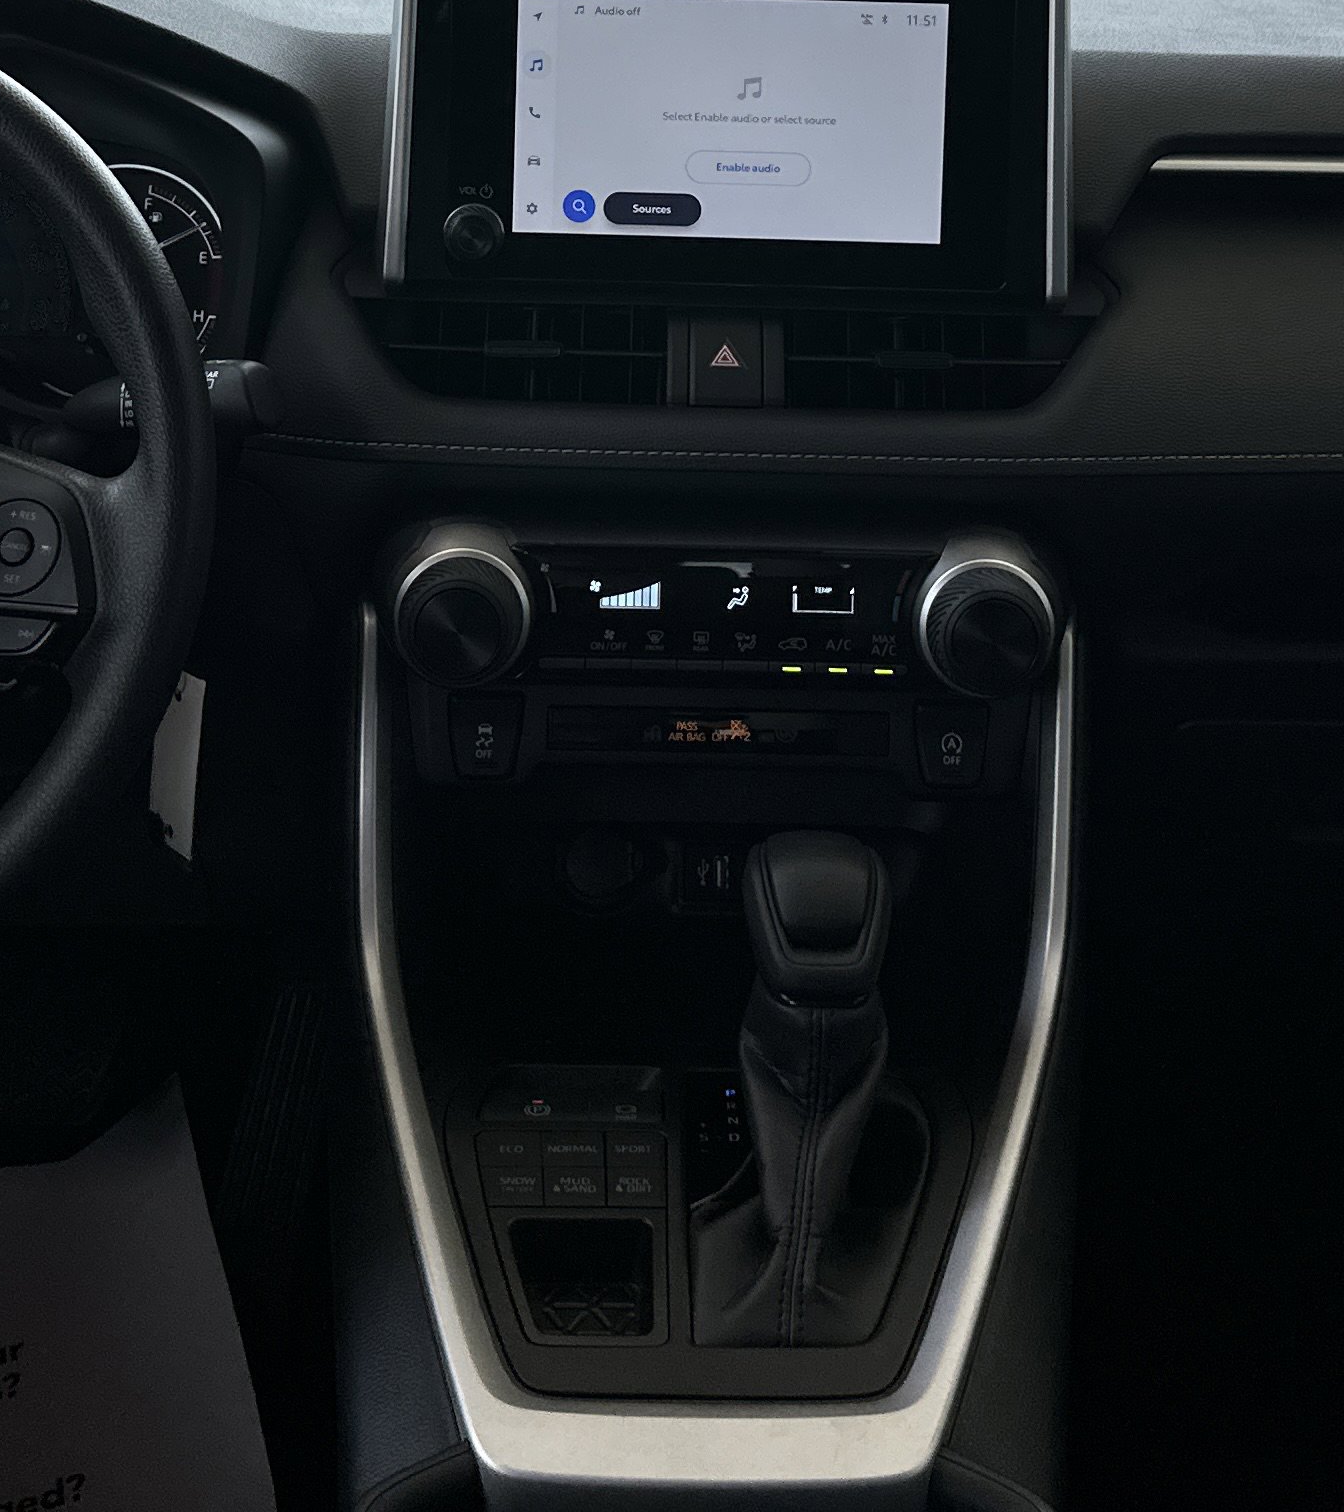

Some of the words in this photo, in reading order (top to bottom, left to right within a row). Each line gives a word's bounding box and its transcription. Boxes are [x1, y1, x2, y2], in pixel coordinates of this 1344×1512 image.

[594, 5, 625, 18] Audio
[626, 6, 642, 18] off
[662, 111, 693, 122] Select
[694, 112, 729, 123] Enable
[730, 113, 760, 124] audio
[761, 116, 773, 124] or
[774, 115, 804, 125] select
[805, 117, 838, 126] source
[716, 162, 752, 173] Enable
[752, 163, 782, 174] audio
[144, 197, 154, 210] F
[632, 203, 673, 215] Sources
[198, 251, 208, 265] E
[193, 310, 205, 323] H
[871, 635, 896, 644] MAX
[589, 641, 627, 652] ON/OFF
[826, 639, 852, 652] A/C
[870, 645, 896, 657] A/C
[676, 720, 699, 731] PASS
[668, 731, 685, 742] AIR
[686, 732, 707, 742] BAG
[475, 749, 493, 759] OFF
[942, 755, 961, 766] OFF
[727, 1116, 739, 1125] N
[728, 1132, 741, 1142] D
[499, 1144, 525, 1154] ECO
[547, 1144, 598, 1154] NORMAL
[614, 1144, 652, 1154] SPORT
[499, 1176, 537, 1186] SNOW
[560, 1176, 591, 1186] MUD
[563, 1184, 597, 1193] SAND
